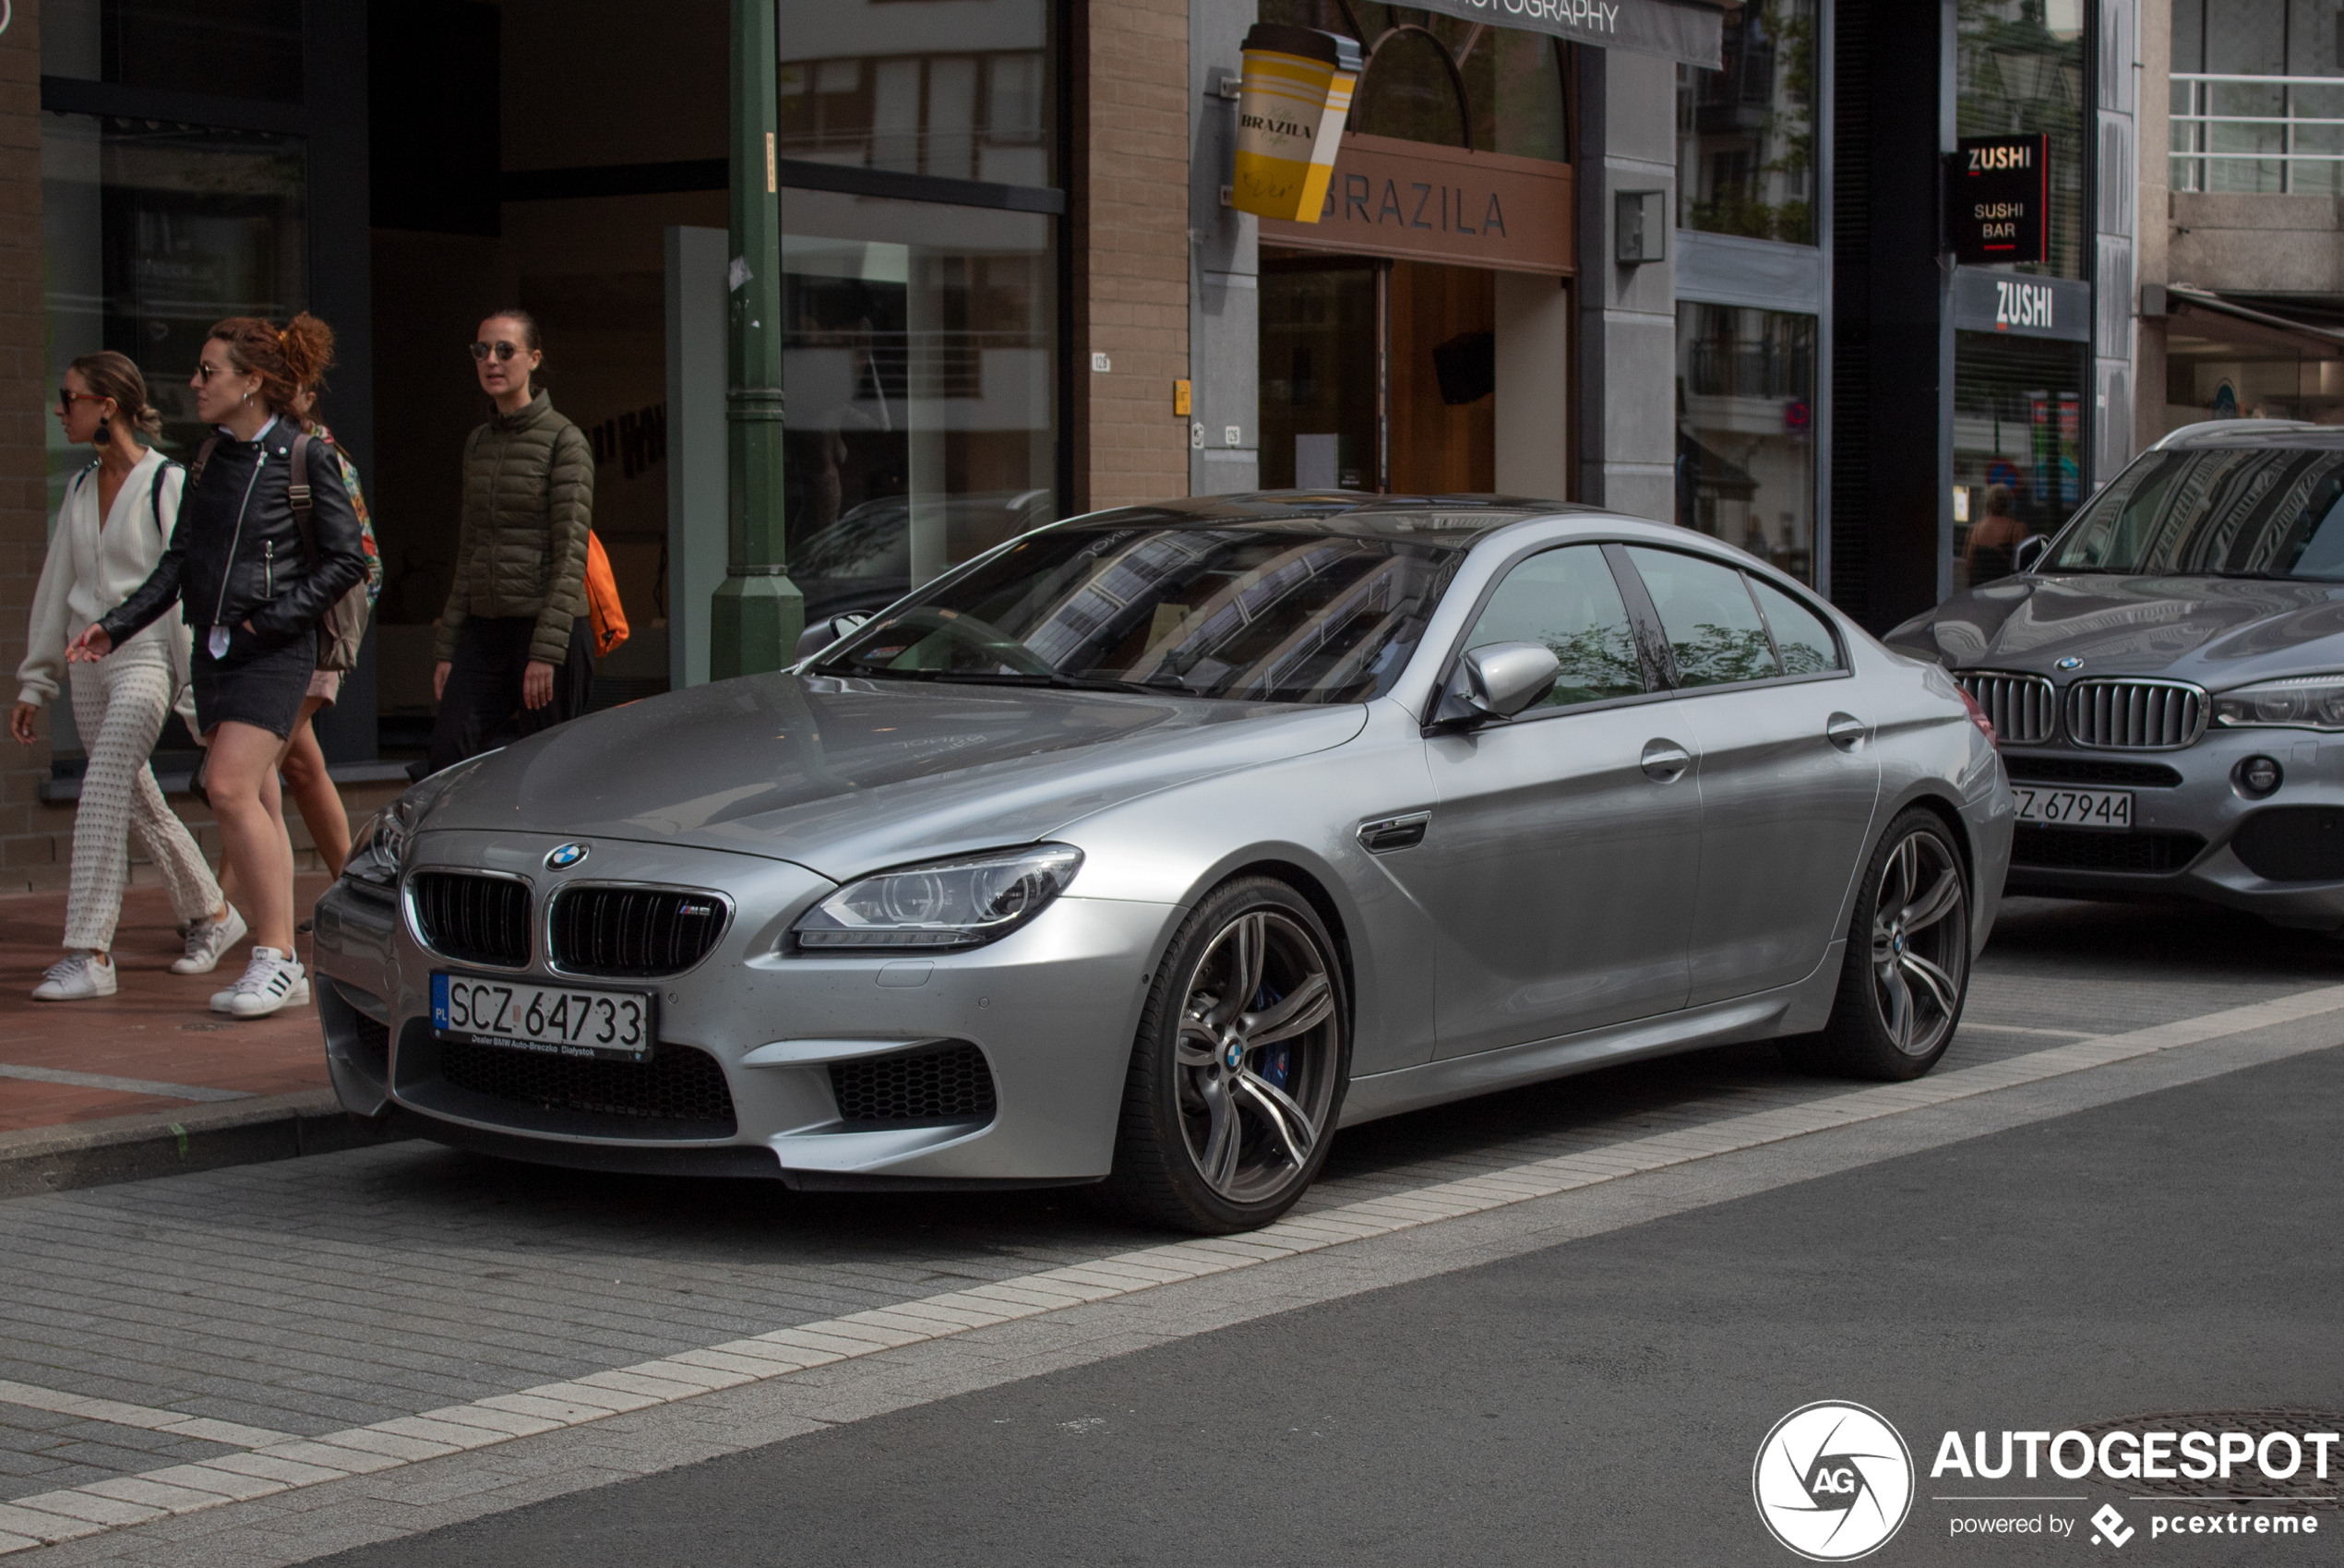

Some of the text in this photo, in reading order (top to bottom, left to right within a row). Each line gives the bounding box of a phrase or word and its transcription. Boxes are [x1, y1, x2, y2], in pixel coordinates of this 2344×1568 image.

[1453, 0, 1619, 33] OGRAPHY
[1240, 114, 1311, 138] BRAZILA
[1968, 146, 2031, 170] ZUSHI
[1975, 203, 2024, 219] SUSHI
[1983, 223, 2015, 238] BAR
[1996, 281, 2052, 328] ZUSHI
[1095, 355, 1107, 369] 128
[1227, 429, 1238, 442] 126
[2045, 792, 2128, 824] 67944
[435, 1007, 448, 1023] PL
[450, 981, 641, 1046] SCZ 64733
[472, 1034, 493, 1046] Dealer
[493, 1036, 511, 1048] BMW
[511, 1040, 558, 1054] Auto-Breczko
